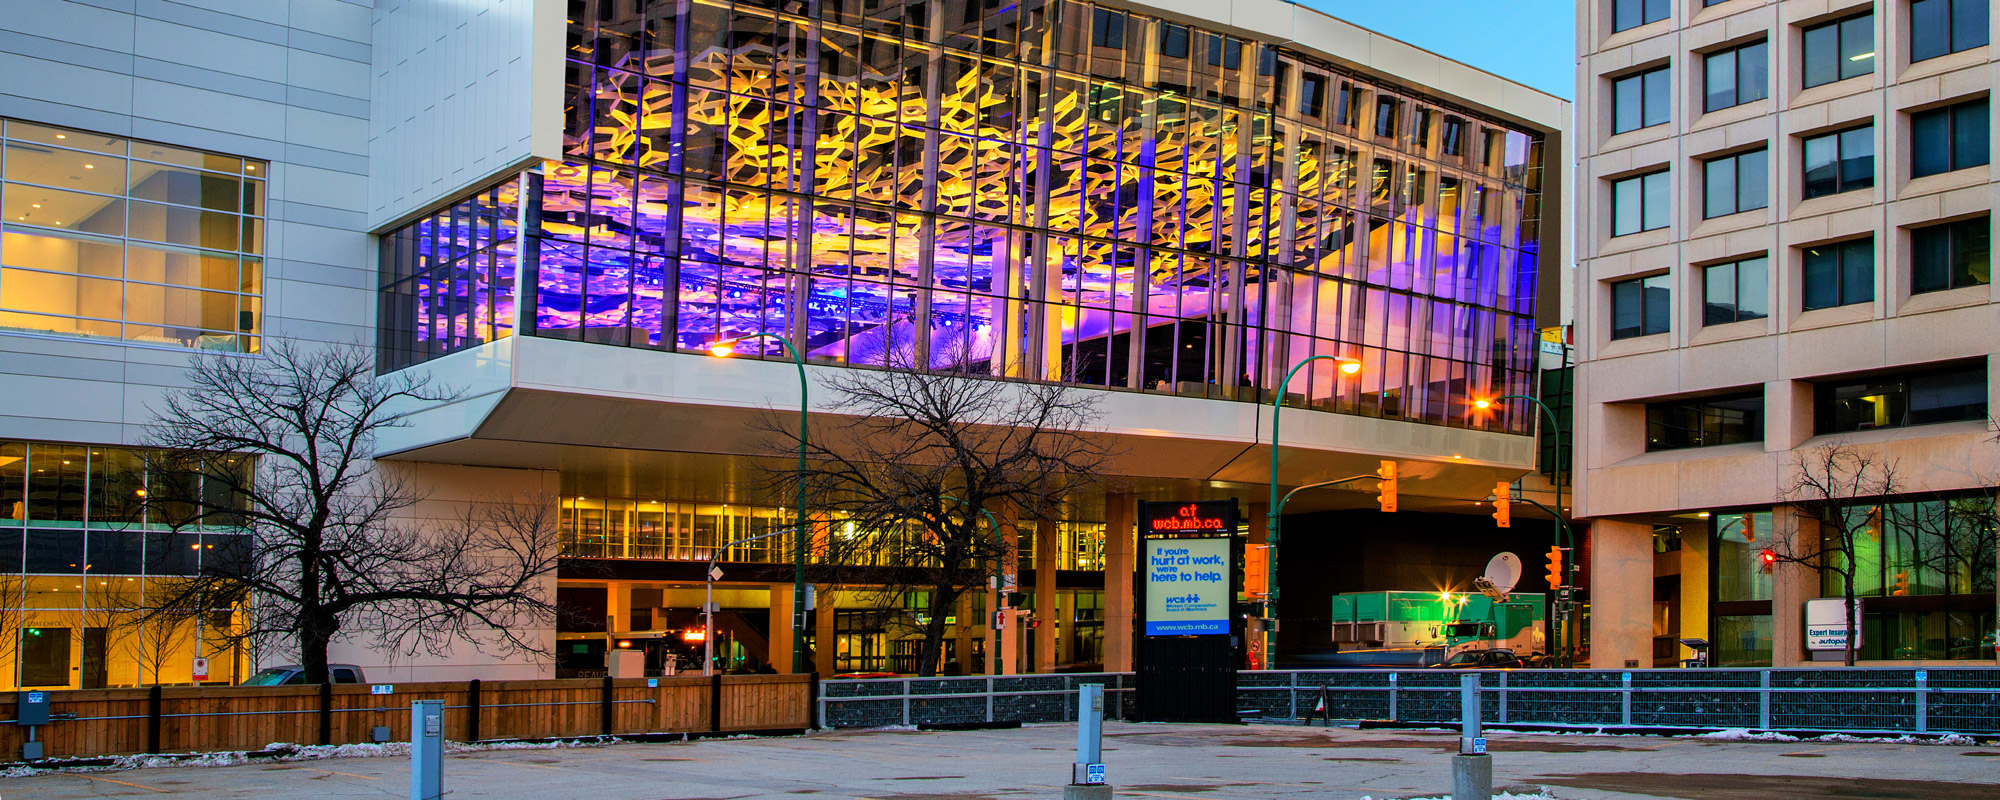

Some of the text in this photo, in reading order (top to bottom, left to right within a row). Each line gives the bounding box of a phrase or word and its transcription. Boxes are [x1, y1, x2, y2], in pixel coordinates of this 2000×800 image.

[1180, 504, 1196, 516] at
[1152, 516, 1223, 530] wcb.mb.ca
[1157, 547, 1189, 557] If you're
[1151, 554, 1224, 567] hurt at work,
[1156, 565, 1178, 573] we're
[1151, 571, 1222, 583] here to help.
[1156, 623, 1219, 631] www.wcb.mb.ca
